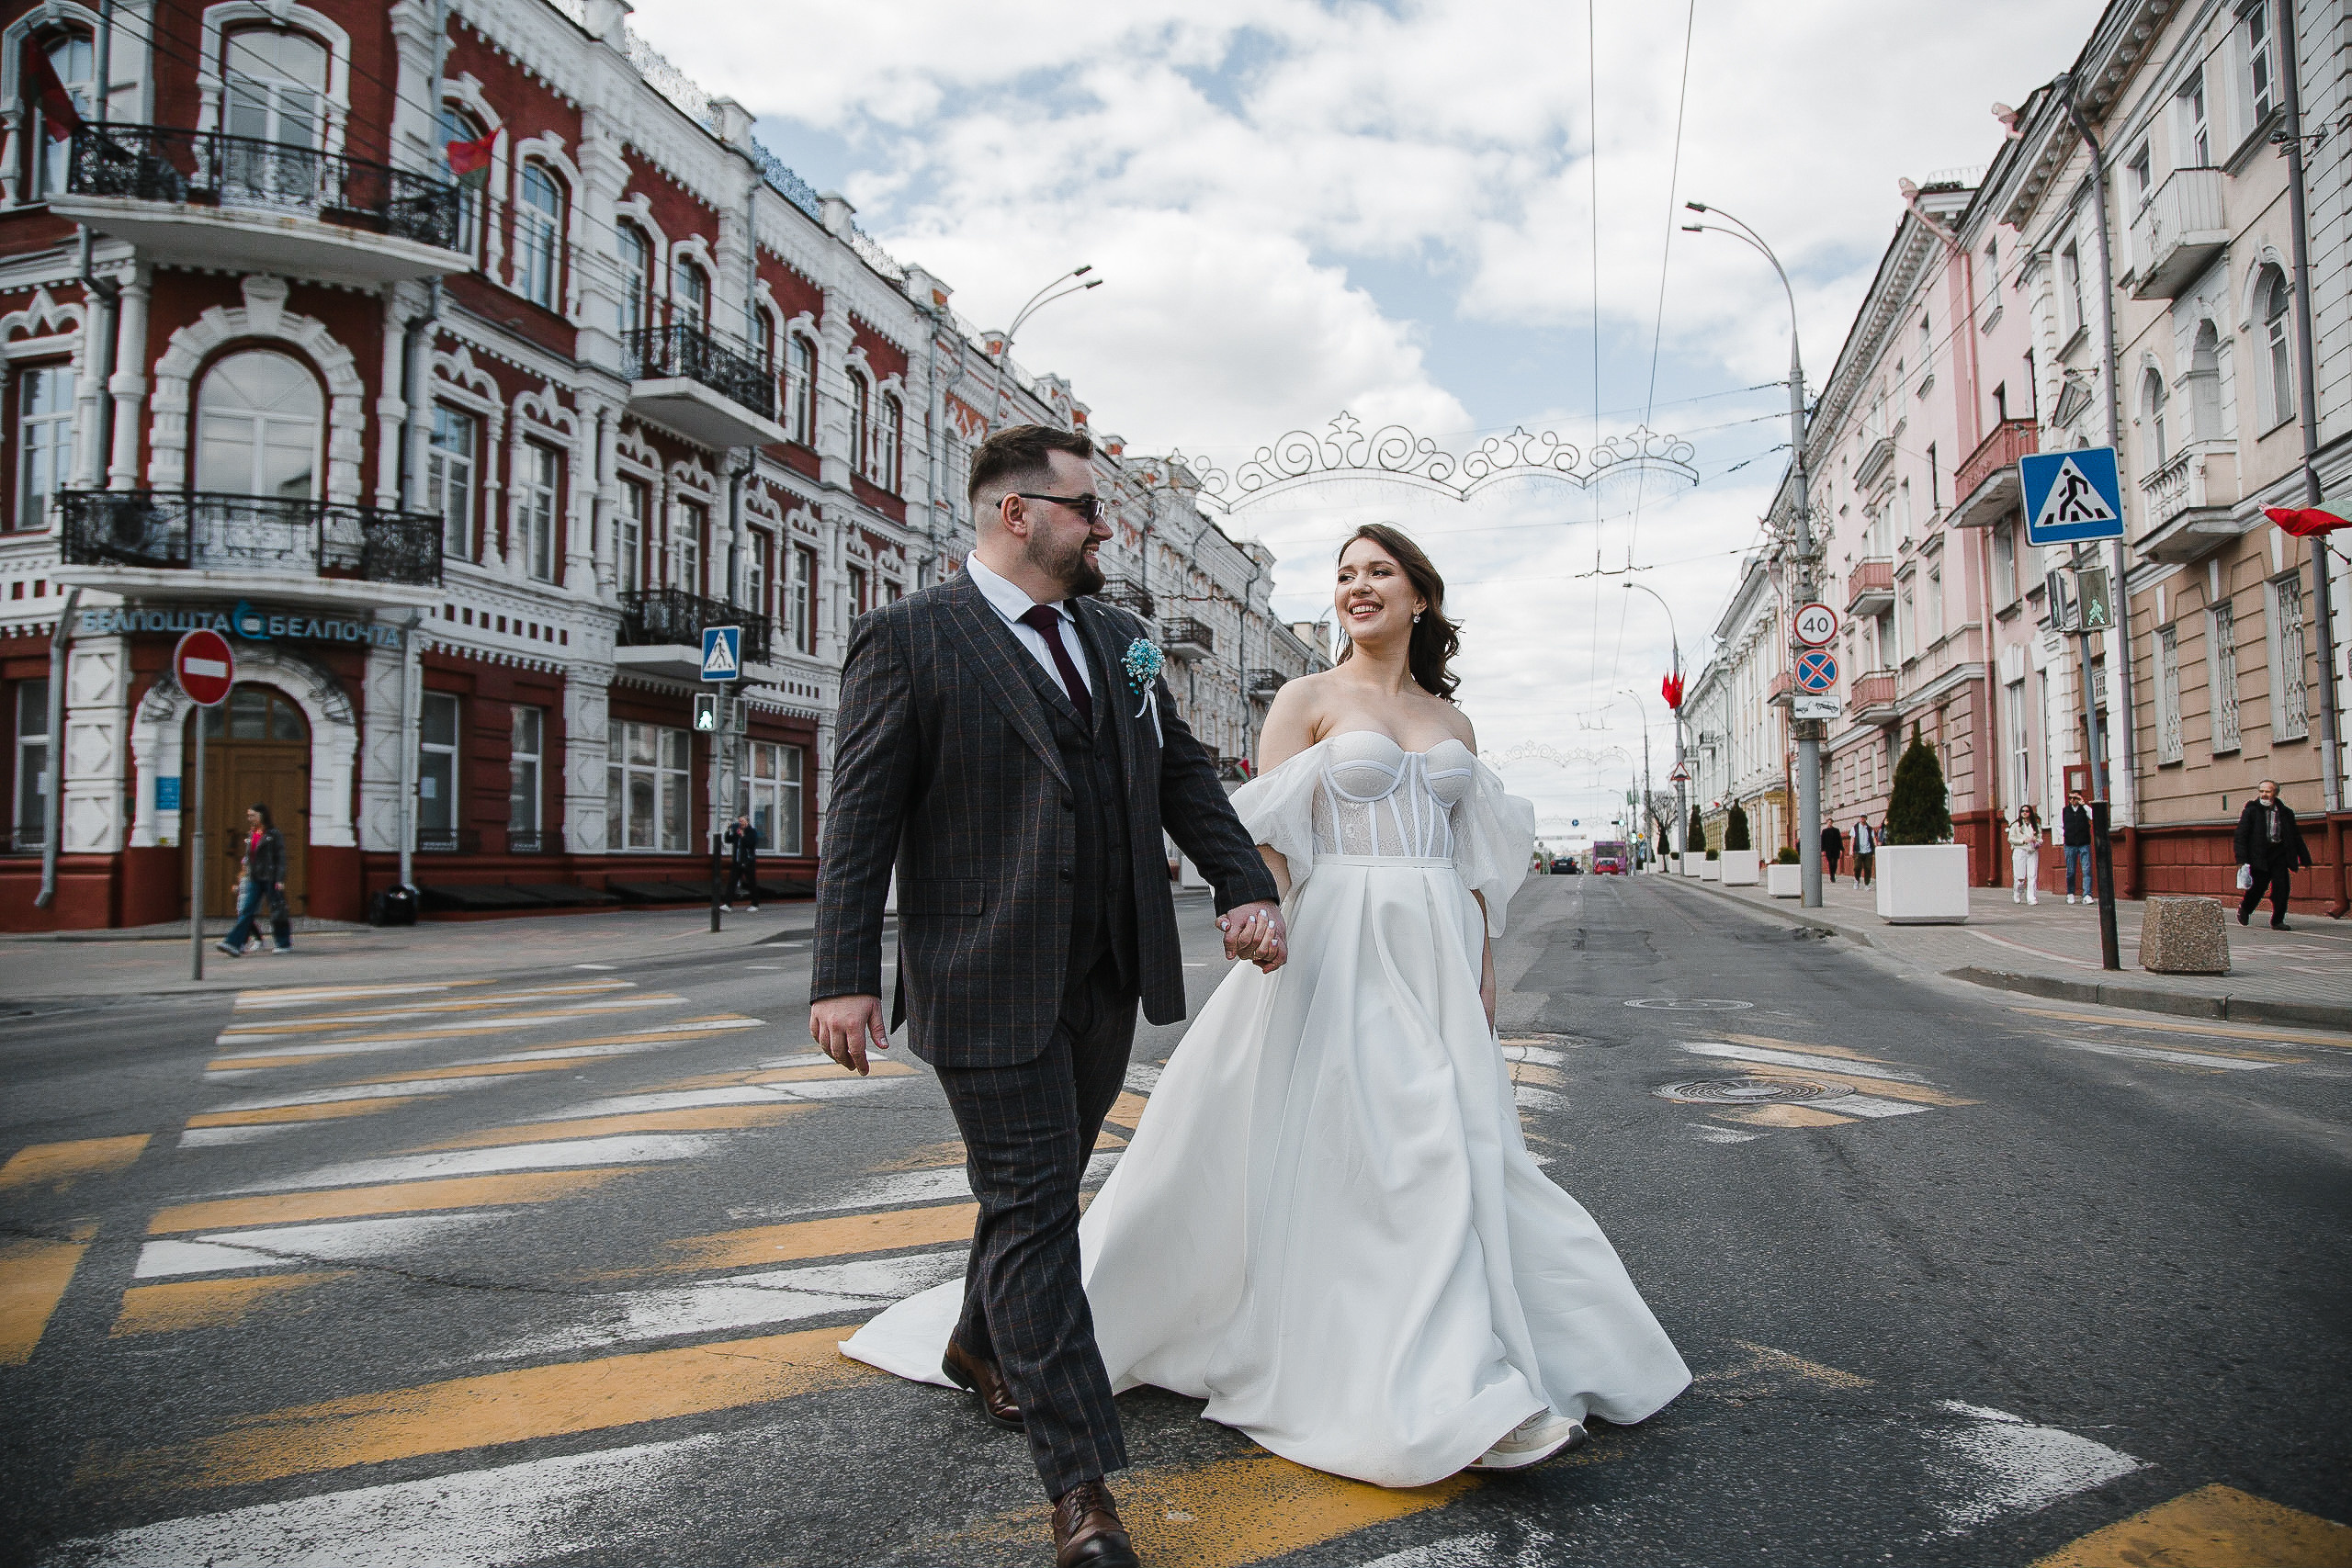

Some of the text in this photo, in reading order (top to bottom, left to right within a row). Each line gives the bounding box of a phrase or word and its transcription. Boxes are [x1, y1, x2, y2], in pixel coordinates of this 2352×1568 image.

[82, 609, 232, 633] БЕЛПОШТА
[269, 615, 400, 648] БЕЛПОЧТА
[1803, 616, 1829, 633] 40
